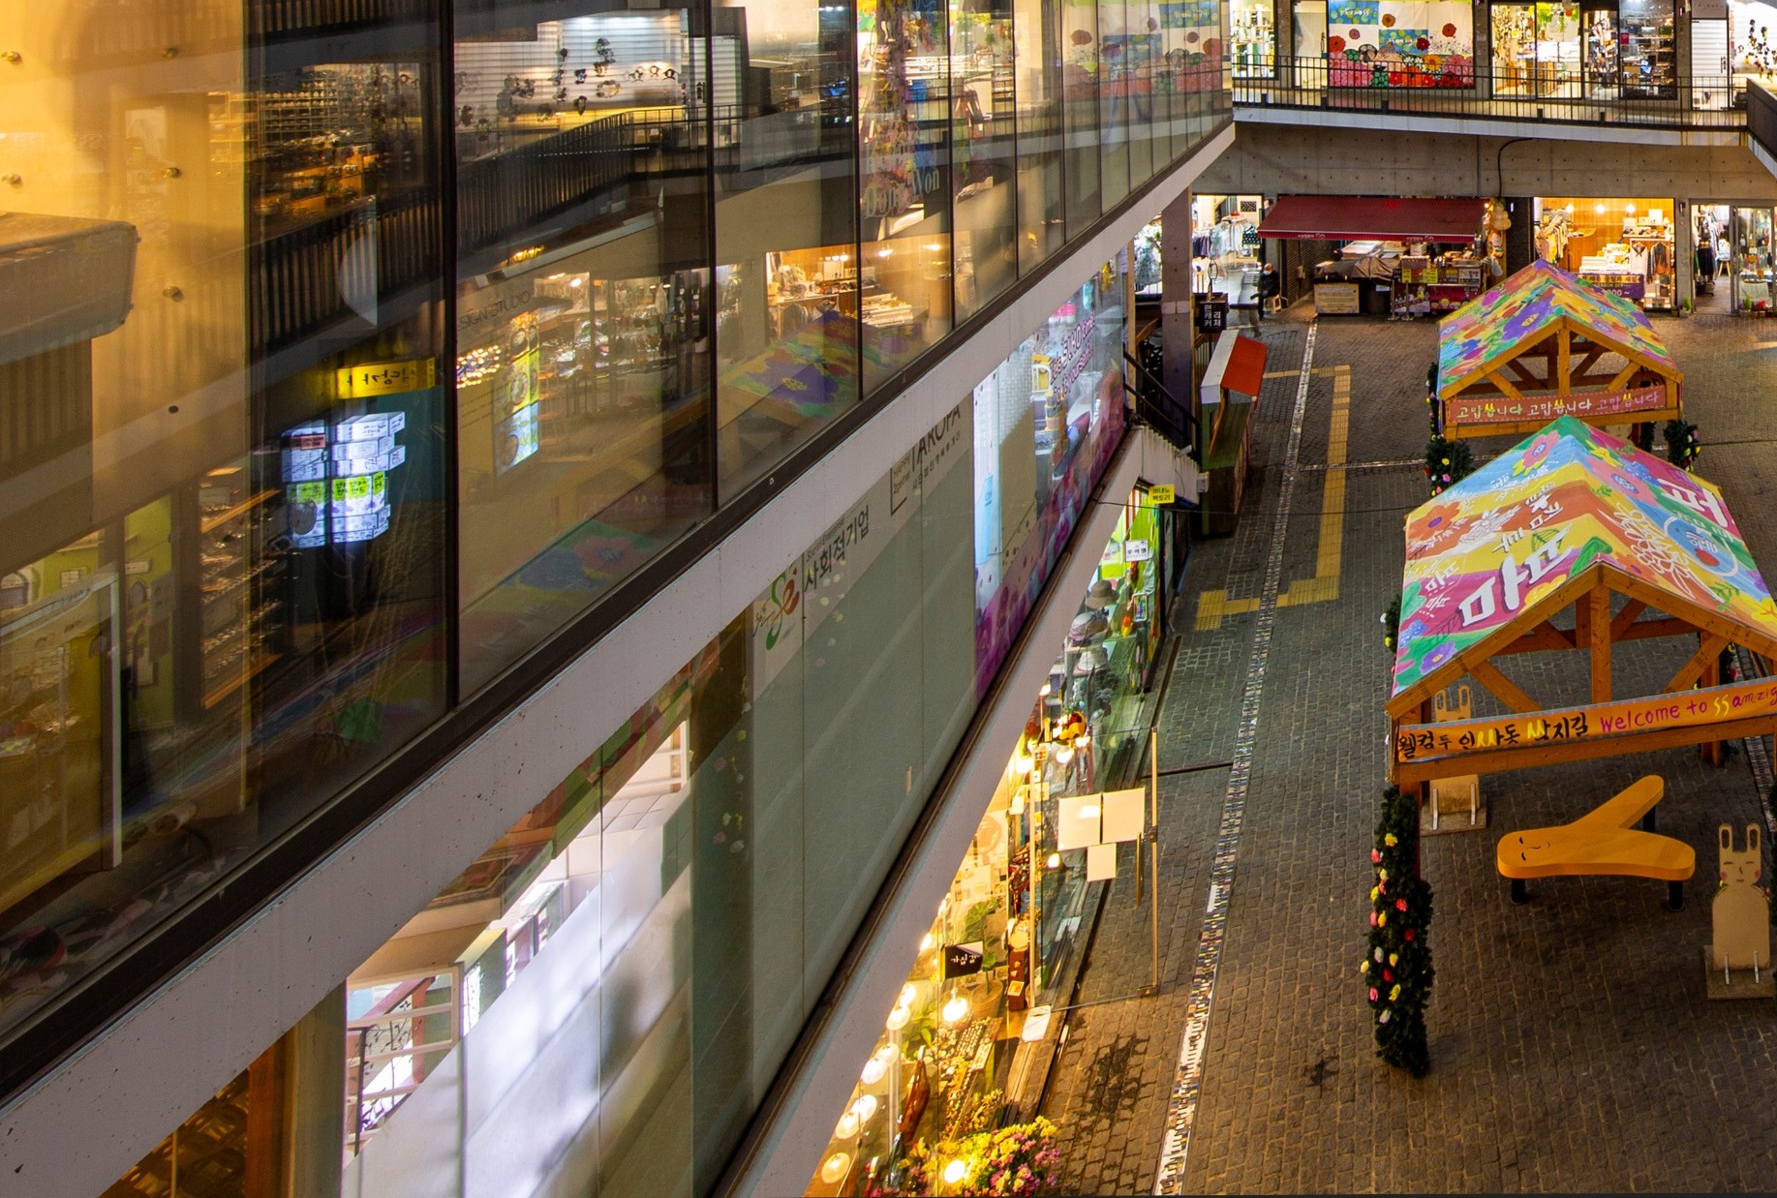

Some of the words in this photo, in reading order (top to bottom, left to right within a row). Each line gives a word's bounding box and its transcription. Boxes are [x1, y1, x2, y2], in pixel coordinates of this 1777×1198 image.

[803, 504, 869, 593] 사회적기업
[1600, 705, 1681, 732] Welcome
[1687, 698, 1708, 714] to
[1398, 730, 1435, 760] 웰컴
